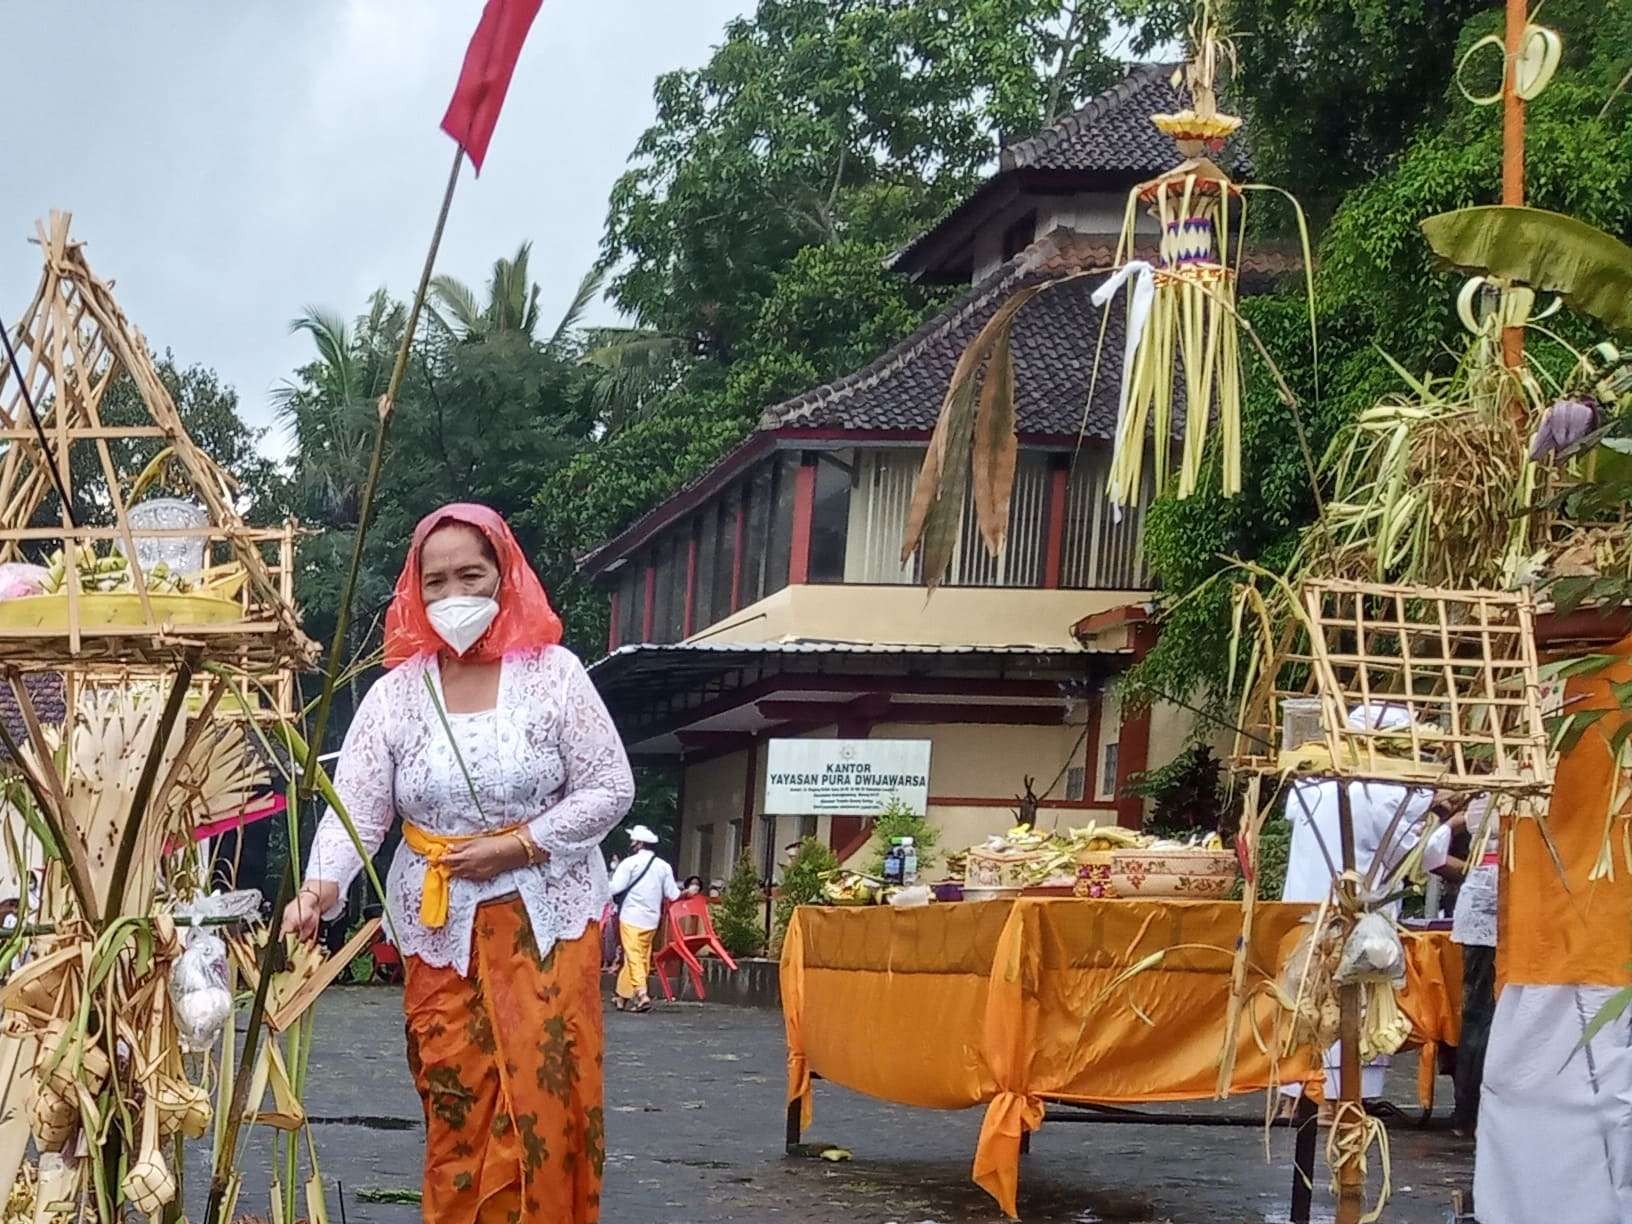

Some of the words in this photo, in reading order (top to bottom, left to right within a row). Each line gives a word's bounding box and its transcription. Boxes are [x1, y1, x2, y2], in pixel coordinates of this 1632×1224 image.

[826, 763, 871, 774] KANTOR
[770, 774, 819, 785] YAYASAN
[821, 774, 851, 786] PURA
[855, 774, 926, 787] DWIJAWARSA
